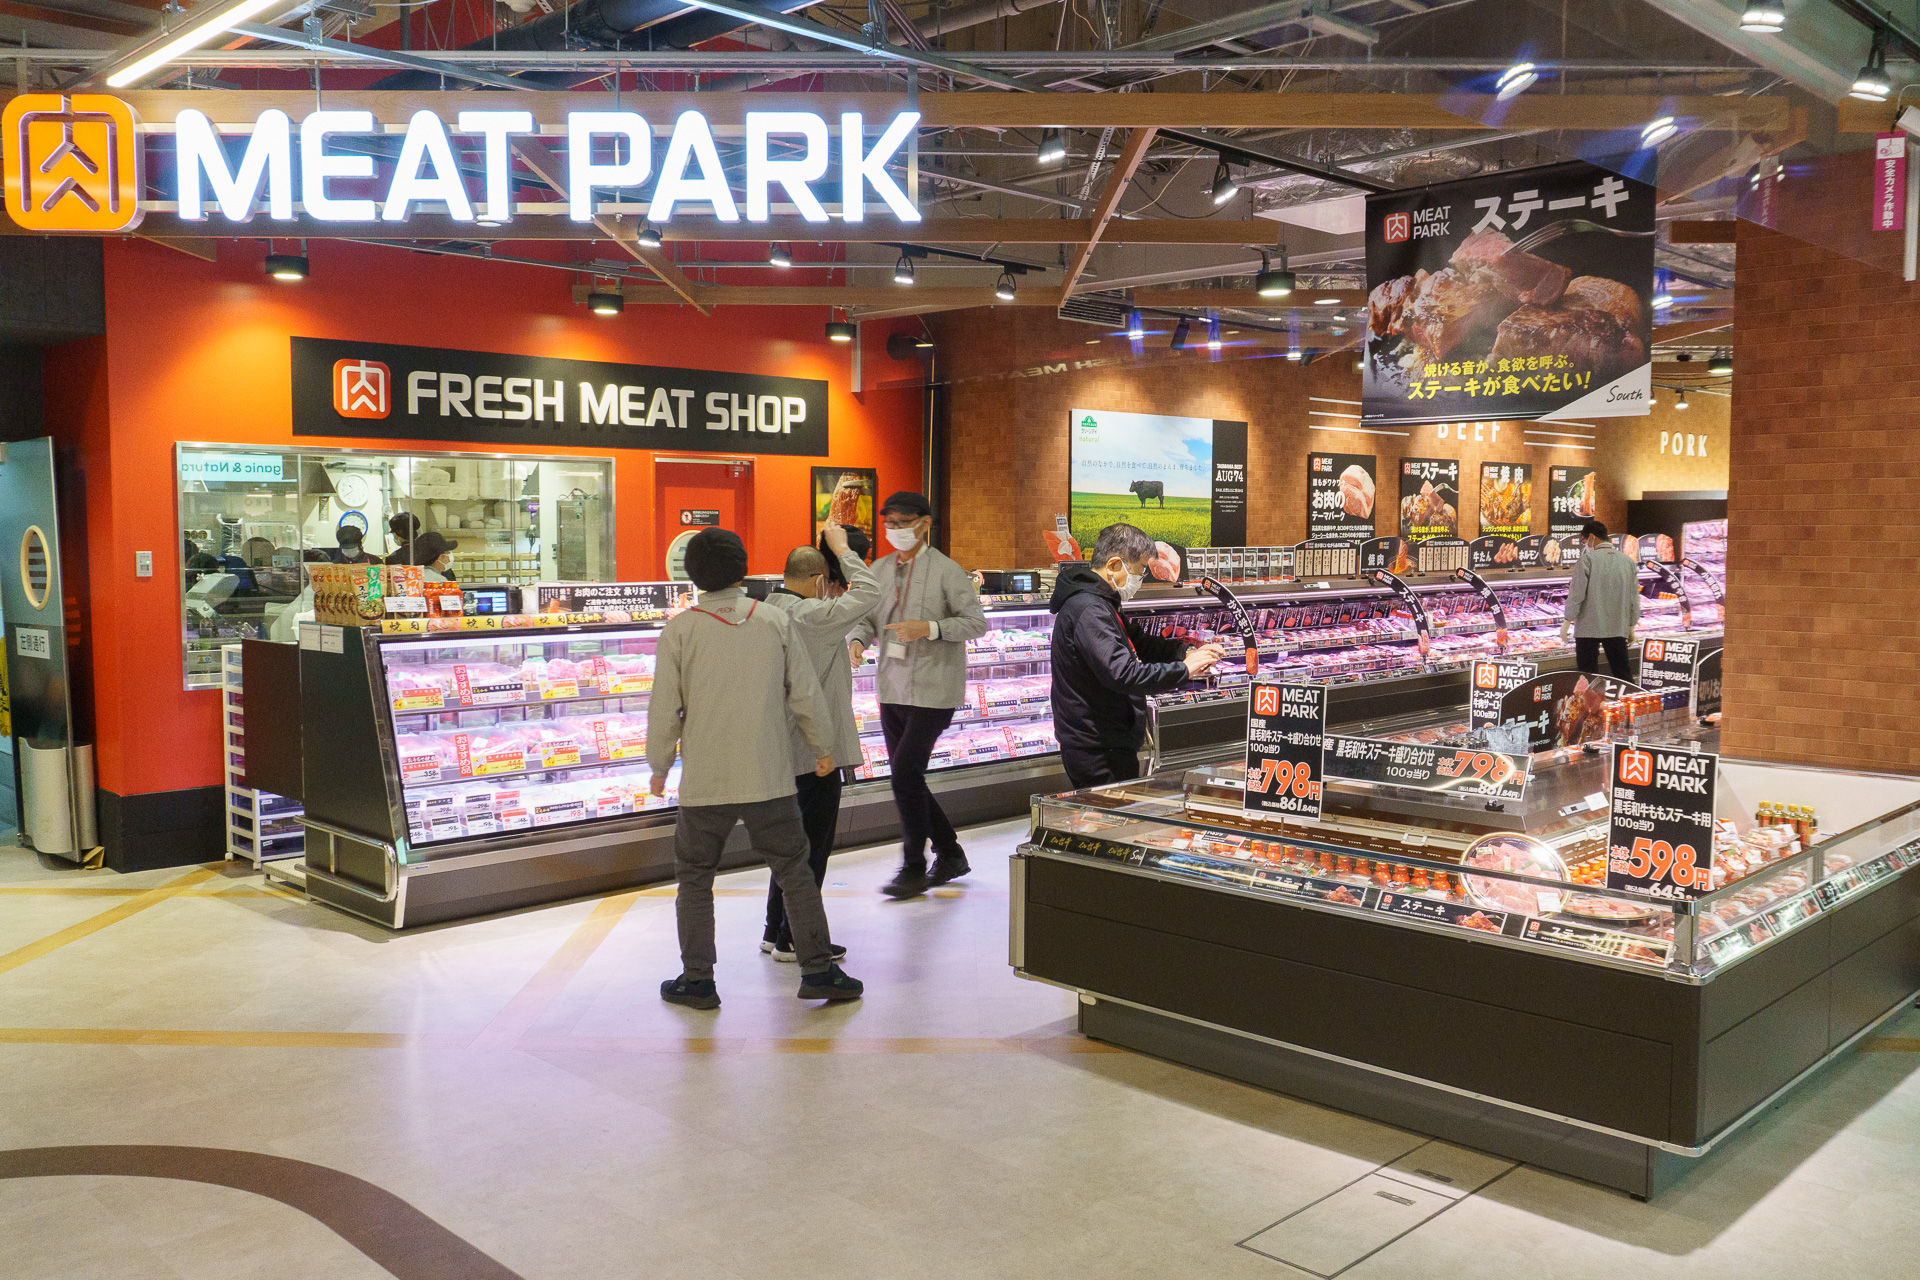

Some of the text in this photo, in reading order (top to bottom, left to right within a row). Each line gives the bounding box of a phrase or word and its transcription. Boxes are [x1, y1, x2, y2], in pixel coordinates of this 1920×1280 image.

[175, 108, 922, 222] MEAT PARK
[1881, 159, 1897, 229] 安全カメラ作動中
[1413, 205, 1452, 223] MEAT
[1471, 176, 1630, 235] ステーキ
[1413, 222, 1451, 240] PARK
[1424, 354, 1575, 378] 焼ける音が、食欲を呼ぶ。
[407, 370, 808, 434] FRESH MEAT SHOP
[1606, 385, 1644, 403] South
[1660, 431, 1708, 457] PORK
[1420, 462, 1458, 481] ステーキ
[1312, 489, 1346, 509] お肉の
[1552, 496, 1581, 513] すきやき
[1312, 511, 1346, 521] テーマパーク
[1472, 551, 1492, 563] 牛たん
[1519, 549, 1539, 561] ホルモン
[574, 587, 622, 598] お肉のご注文
[1399, 587, 1425, 623] ステーキ
[1227, 599, 1253, 637] かたまり
[1665, 642, 1695, 654] MEAT
[1664, 653, 1692, 664] PARK
[1499, 665, 1532, 679] MEAT
[455, 666, 472, 704] おすすめ品
[1498, 678, 1526, 690] PAR
[1541, 684, 1553, 692] MEAT
[474, 696, 490, 704] SALE
[1282, 688, 1320, 704] MEAT
[1541, 692, 1552, 701] PARK
[1282, 704, 1319, 719] PARK
[1250, 718, 1266, 728] 国産
[1250, 728, 1321, 747] 黒毛和牛ステーキ盛り合わせ
[456, 735, 473, 775] おすすめ品
[1250, 743, 1280, 754] 100g当り
[1336, 739, 1435, 767] 黒毛和牛ステーキ盛り合わせ
[1386, 766, 1430, 780] 100g当り
[1657, 754, 1709, 775] MEAT
[1656, 772, 1708, 794] PARK
[1614, 787, 1635, 800] 国産
[536, 815, 551, 824] SALE
[1613, 799, 1712, 828] 黒毛和牛ももステーキ用
[1613, 816, 1655, 832] 100g当り
[1401, 899, 1446, 916] ステーキ
